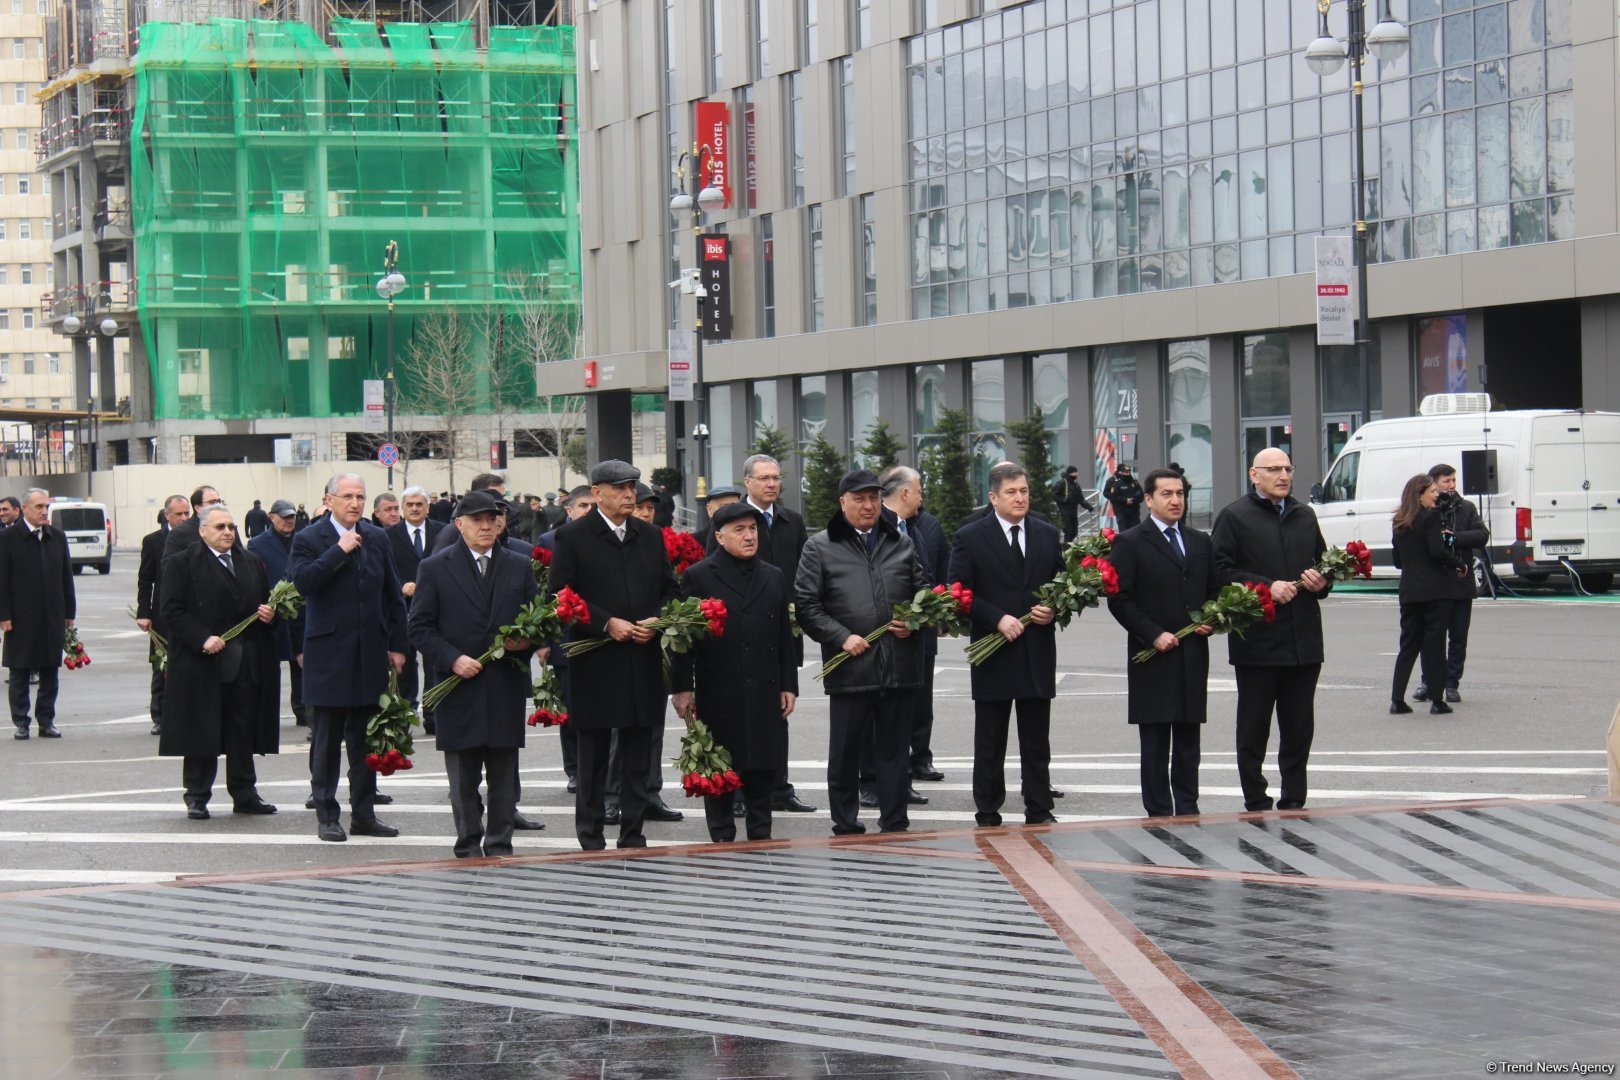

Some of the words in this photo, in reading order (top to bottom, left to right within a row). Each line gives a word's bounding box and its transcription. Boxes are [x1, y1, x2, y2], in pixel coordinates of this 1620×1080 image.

[714, 121, 723, 155] HOTEL
[707, 243, 723, 254] ibis
[711, 269, 720, 332] HOTEL
